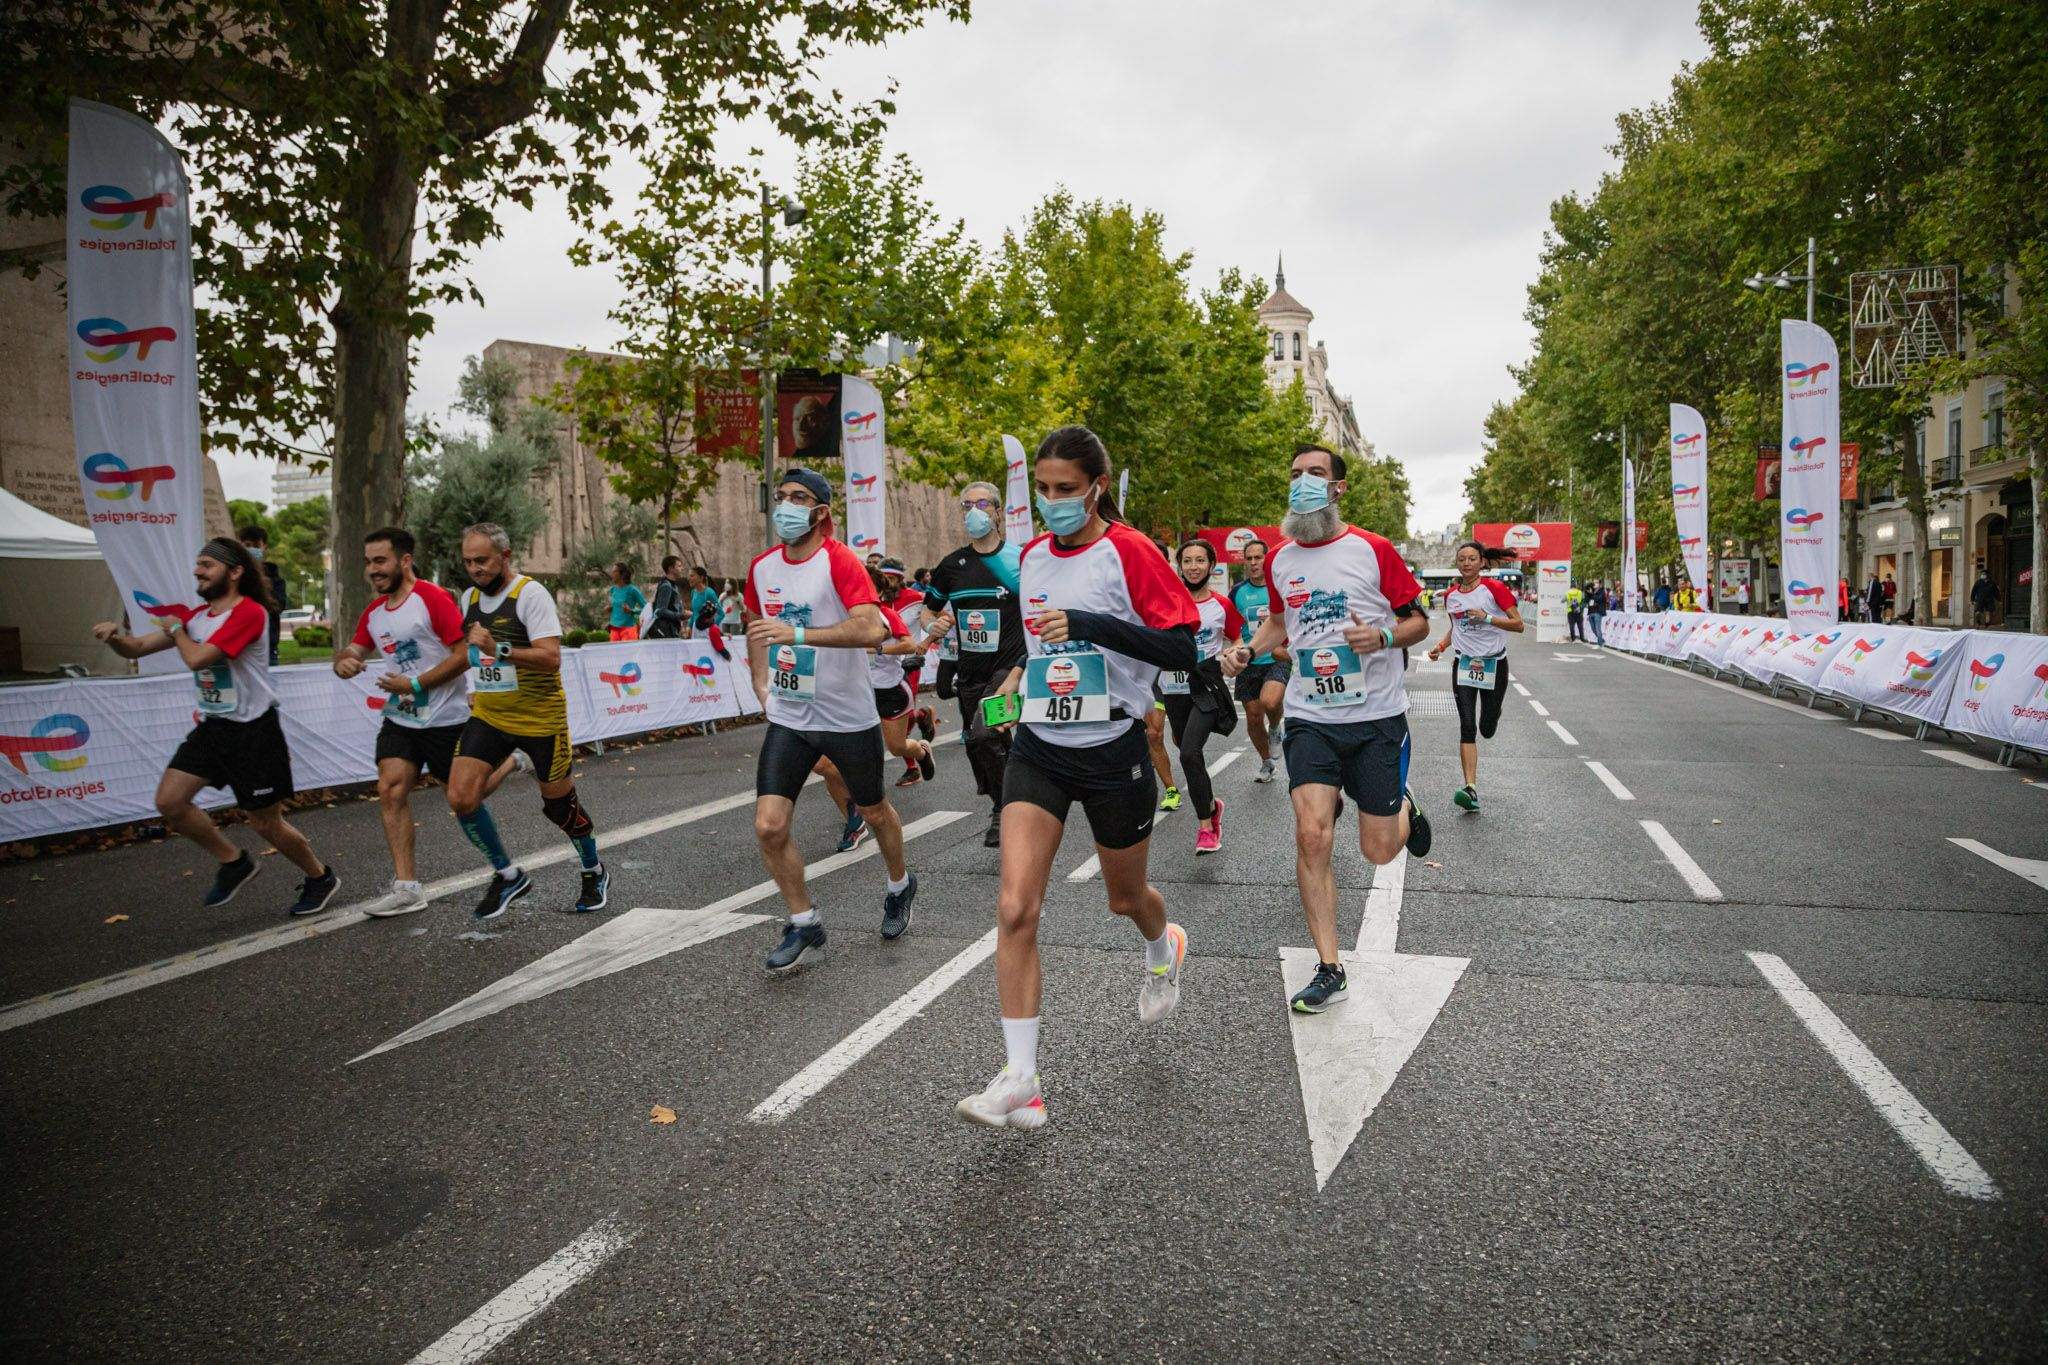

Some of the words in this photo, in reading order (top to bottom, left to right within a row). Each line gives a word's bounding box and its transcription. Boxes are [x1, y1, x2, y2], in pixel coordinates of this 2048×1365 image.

[967, 631, 987, 643] 490
[480, 668, 501, 681] 496
[774, 671, 799, 690] 468
[1469, 671, 1485, 681] 473
[1315, 675, 1345, 695] 518
[1045, 696, 1083, 721] 467
[0, 781, 105, 804] otalEergies
